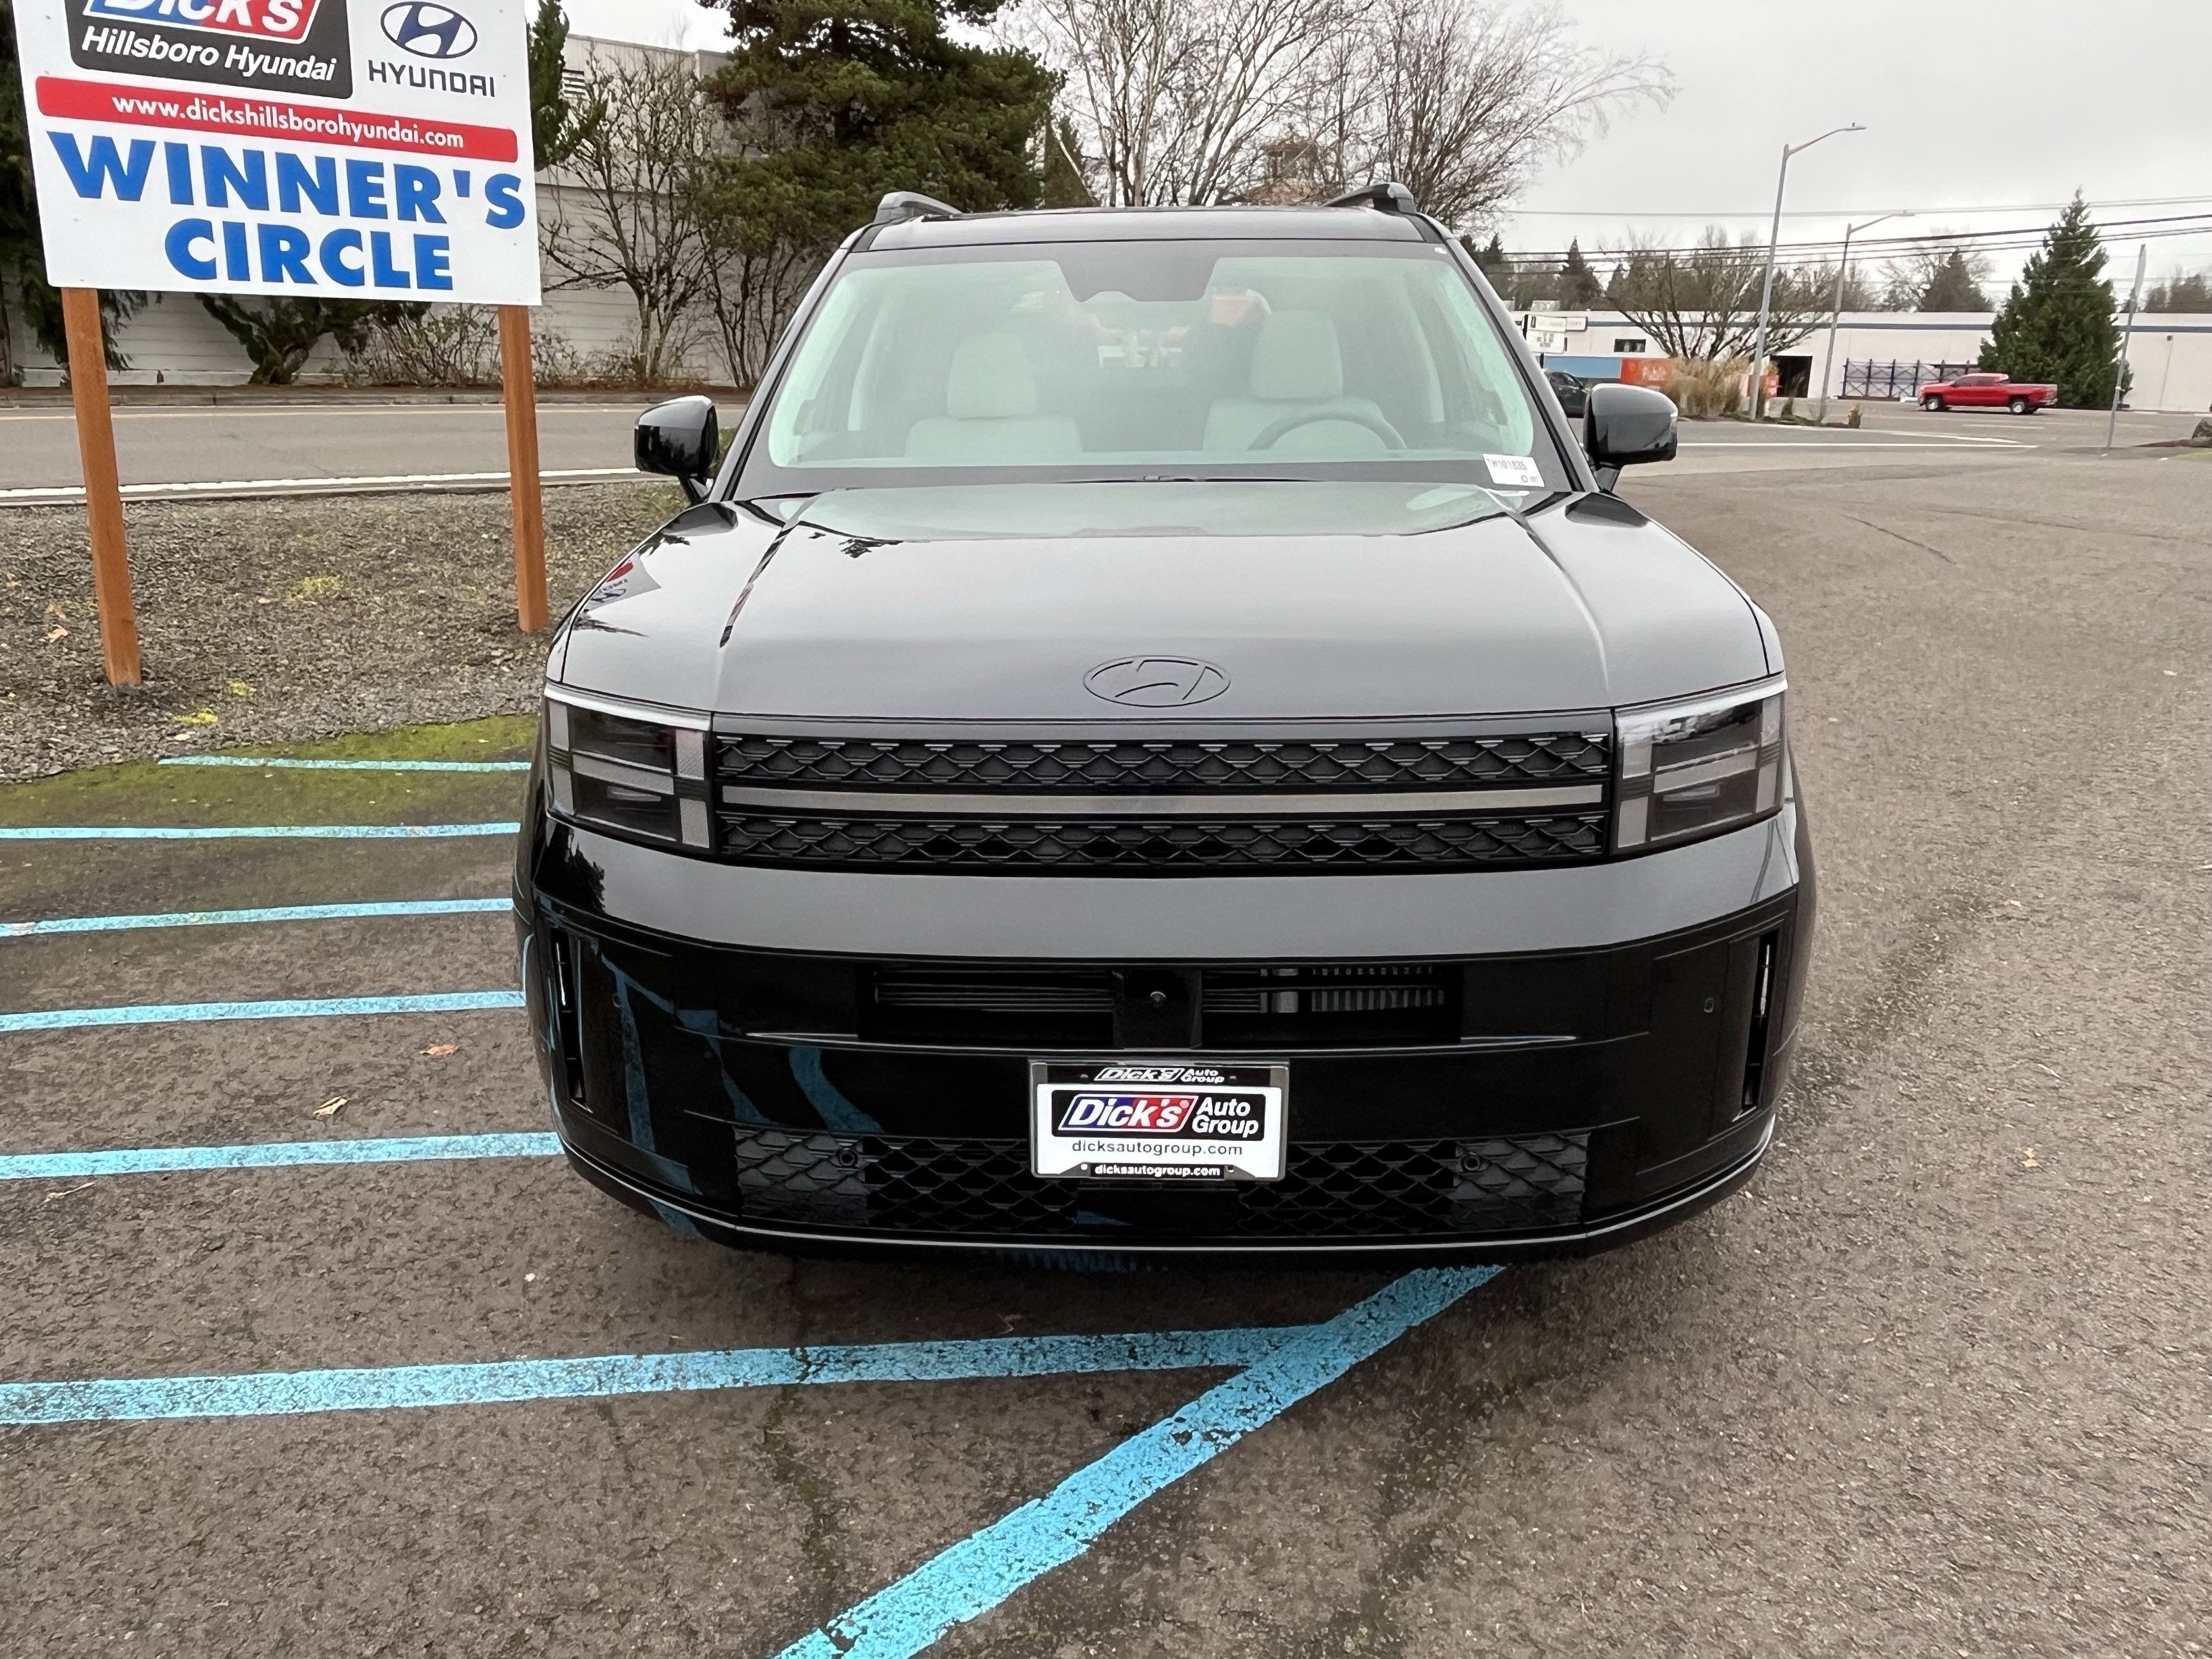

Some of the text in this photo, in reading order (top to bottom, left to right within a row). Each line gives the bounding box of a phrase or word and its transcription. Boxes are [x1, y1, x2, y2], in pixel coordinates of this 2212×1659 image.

[81, 25, 337, 81] Hillsboro Hyundai
[369, 59, 495, 98] HYUNDAI
[112, 93, 464, 150] www.dickshillsborohyundai.com
[46, 131, 525, 229] WINNER'S
[165, 218, 453, 291] CIRCLE
[1181, 1075, 1225, 1084] Group
[1068, 1098, 1182, 1128] Dick's
[1197, 1097, 1250, 1116] Auto
[1192, 1115, 1259, 1138] Group
[1072, 1141, 1243, 1156] dicksautogroup.com
[1094, 1165, 1220, 1177] dicksautogroup.com
